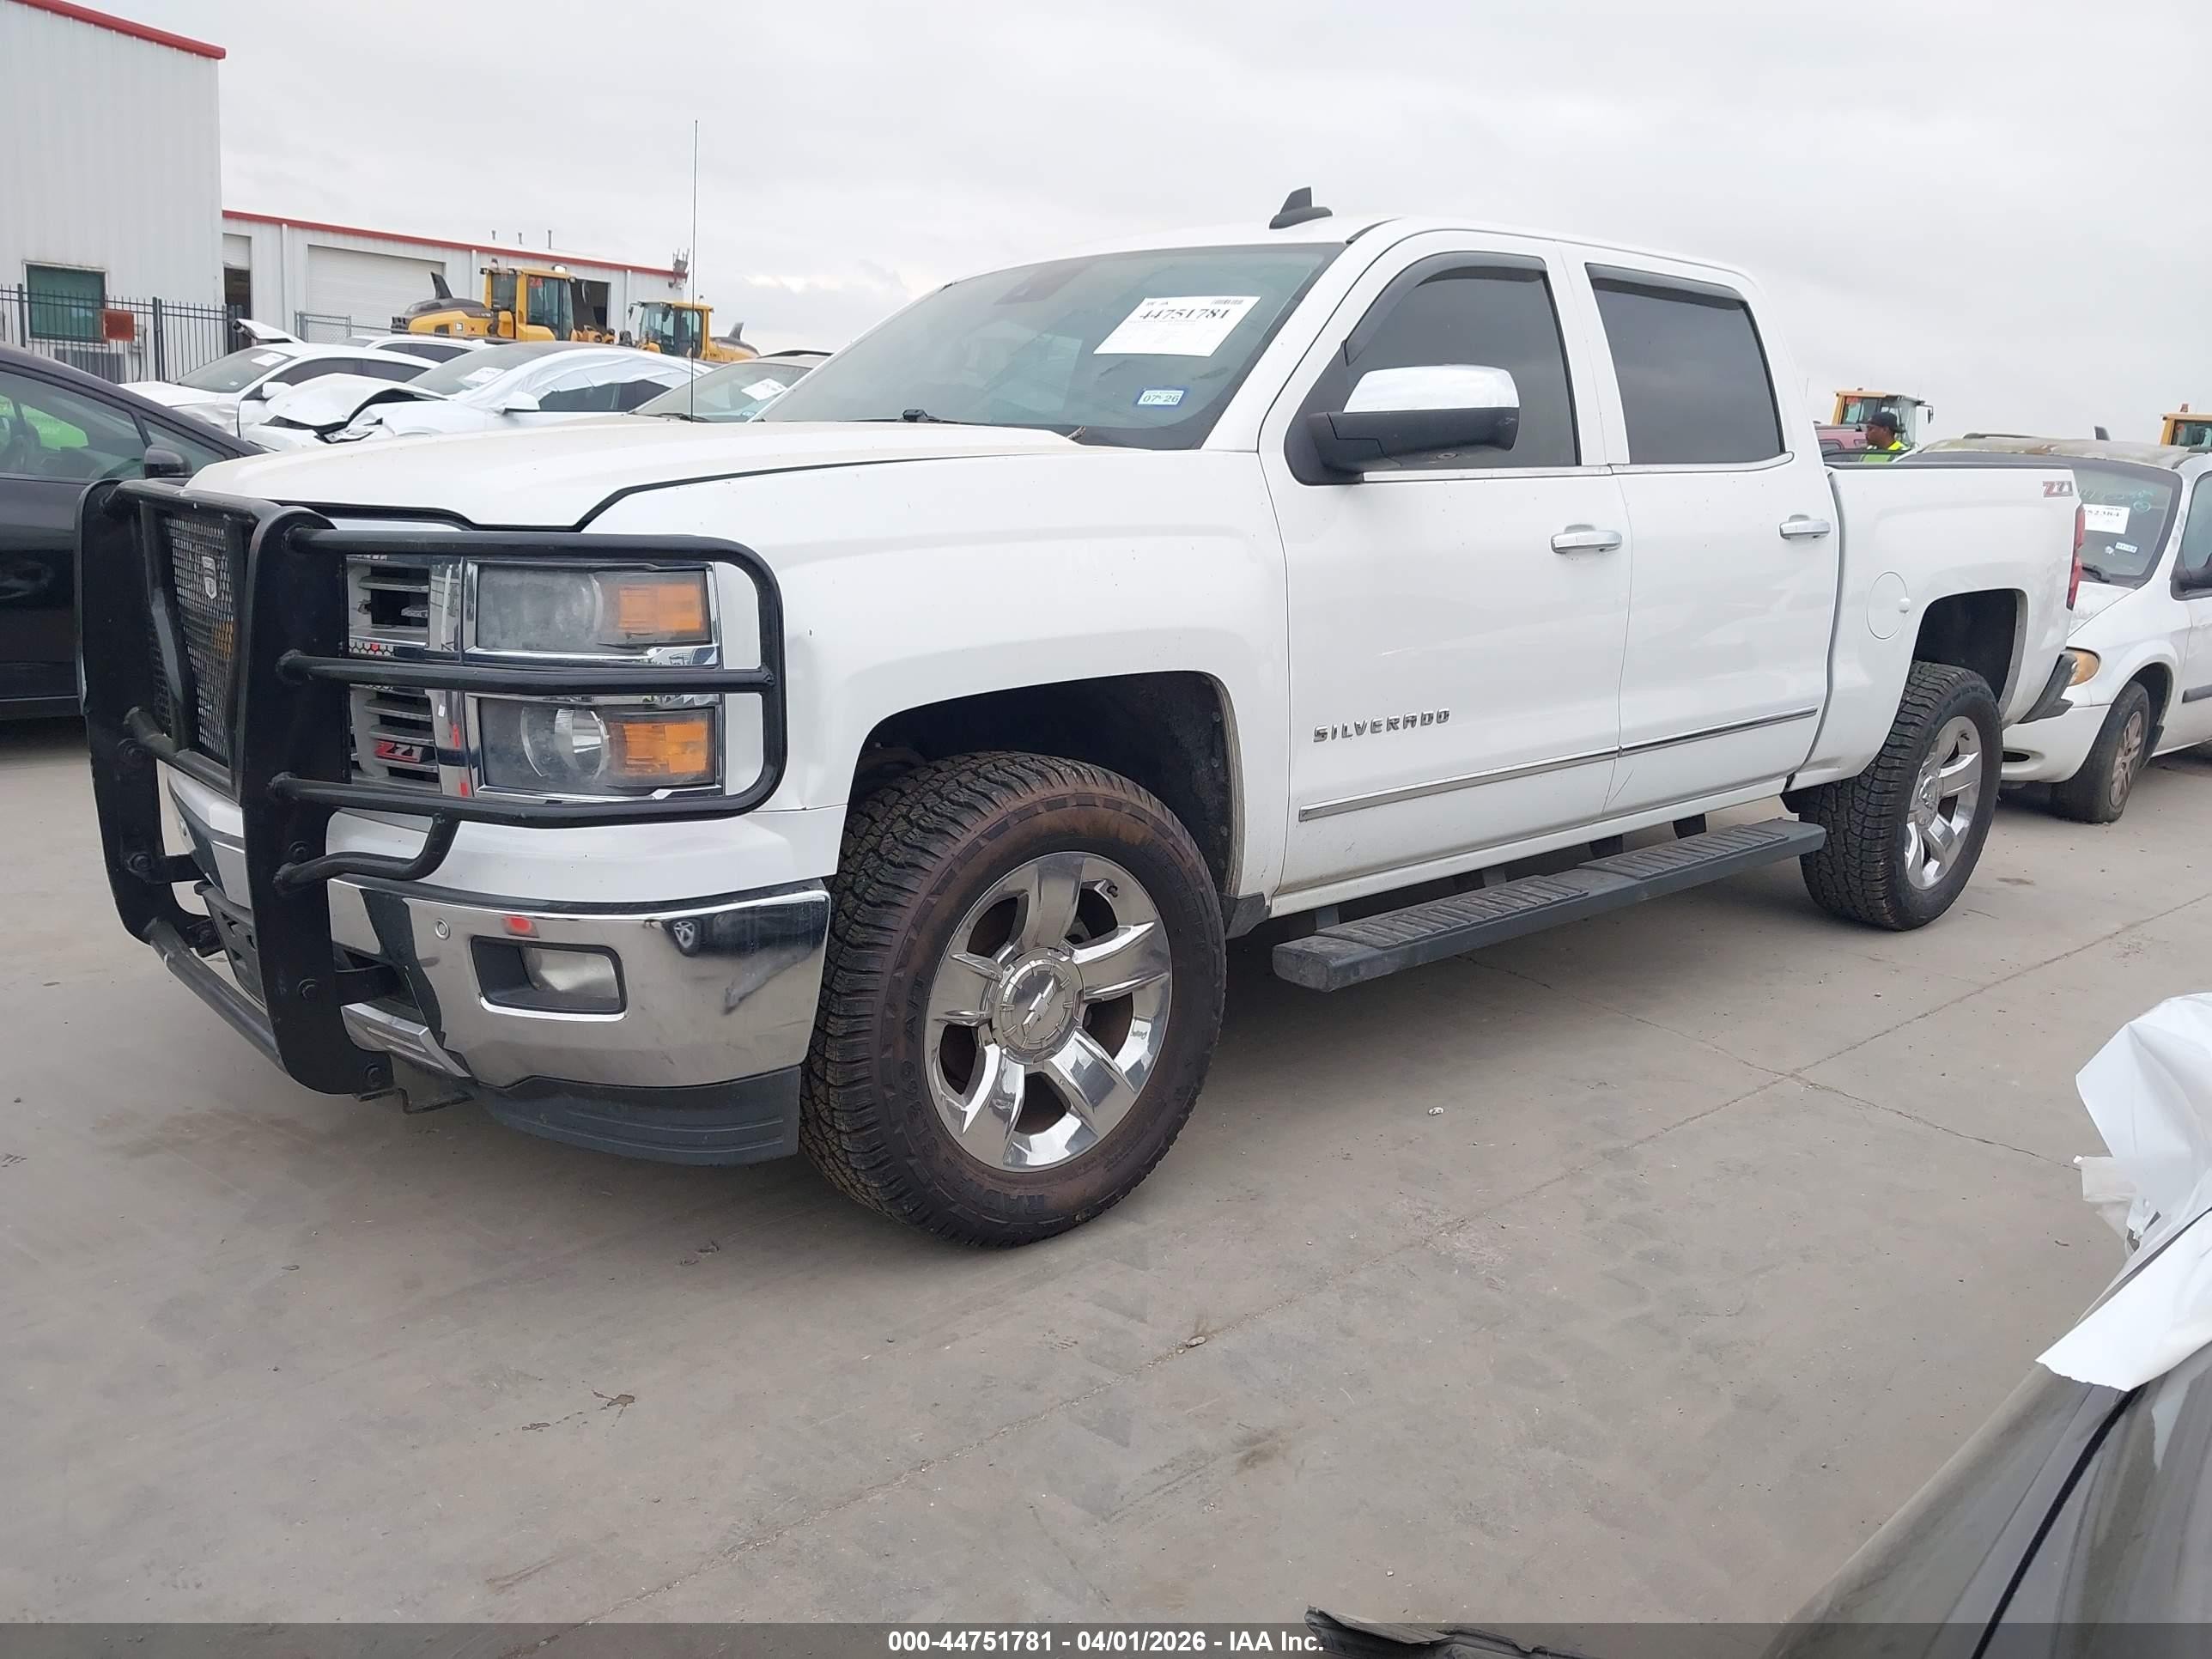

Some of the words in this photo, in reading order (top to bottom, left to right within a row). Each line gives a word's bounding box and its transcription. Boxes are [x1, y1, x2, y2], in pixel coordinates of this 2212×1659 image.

[1139, 308, 1230, 319] 44751781
[2043, 481, 2073, 498] Z71
[1313, 708, 1449, 743] SILVERADO
[374, 741, 423, 763] Z71
